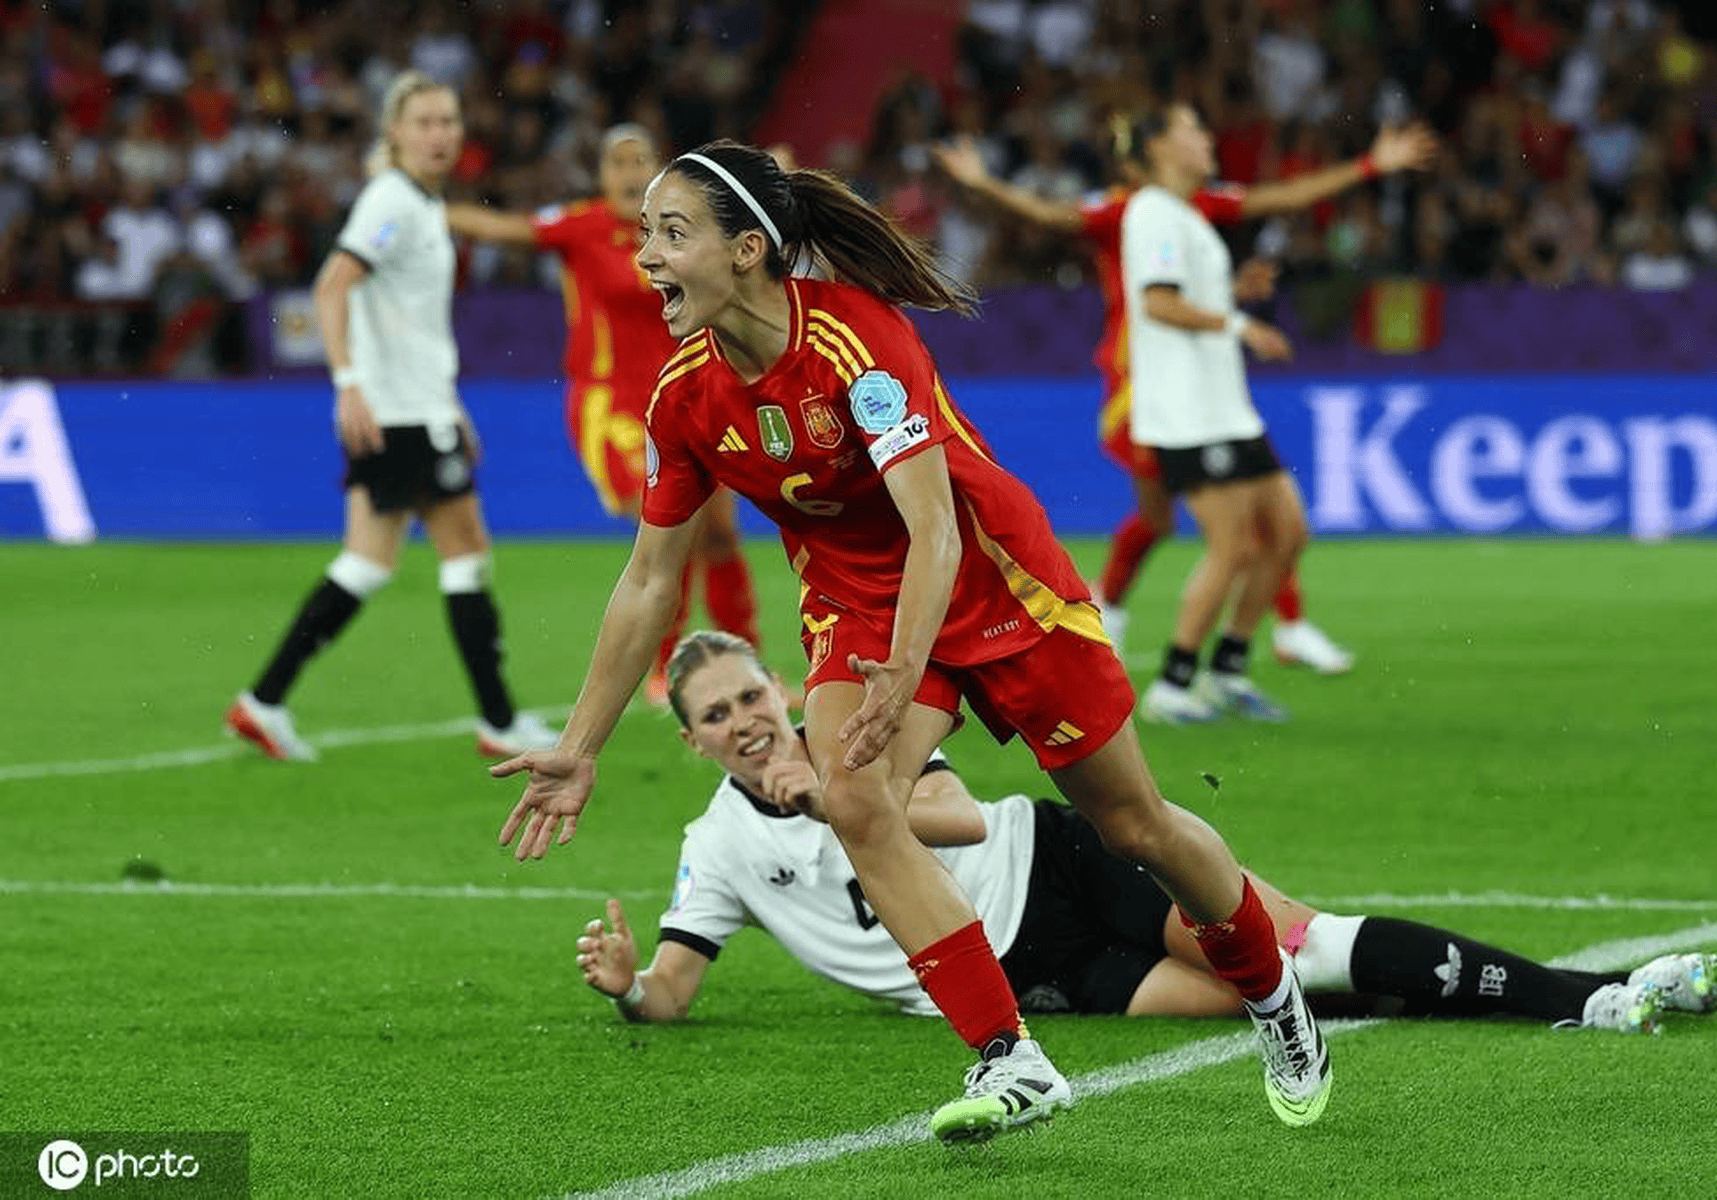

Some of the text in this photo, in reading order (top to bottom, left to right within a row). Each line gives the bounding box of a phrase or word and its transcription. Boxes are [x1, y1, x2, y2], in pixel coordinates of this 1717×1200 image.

[0, 379, 97, 544] A
[780, 472, 844, 516] 6
[1303, 384, 1717, 542] Keep
